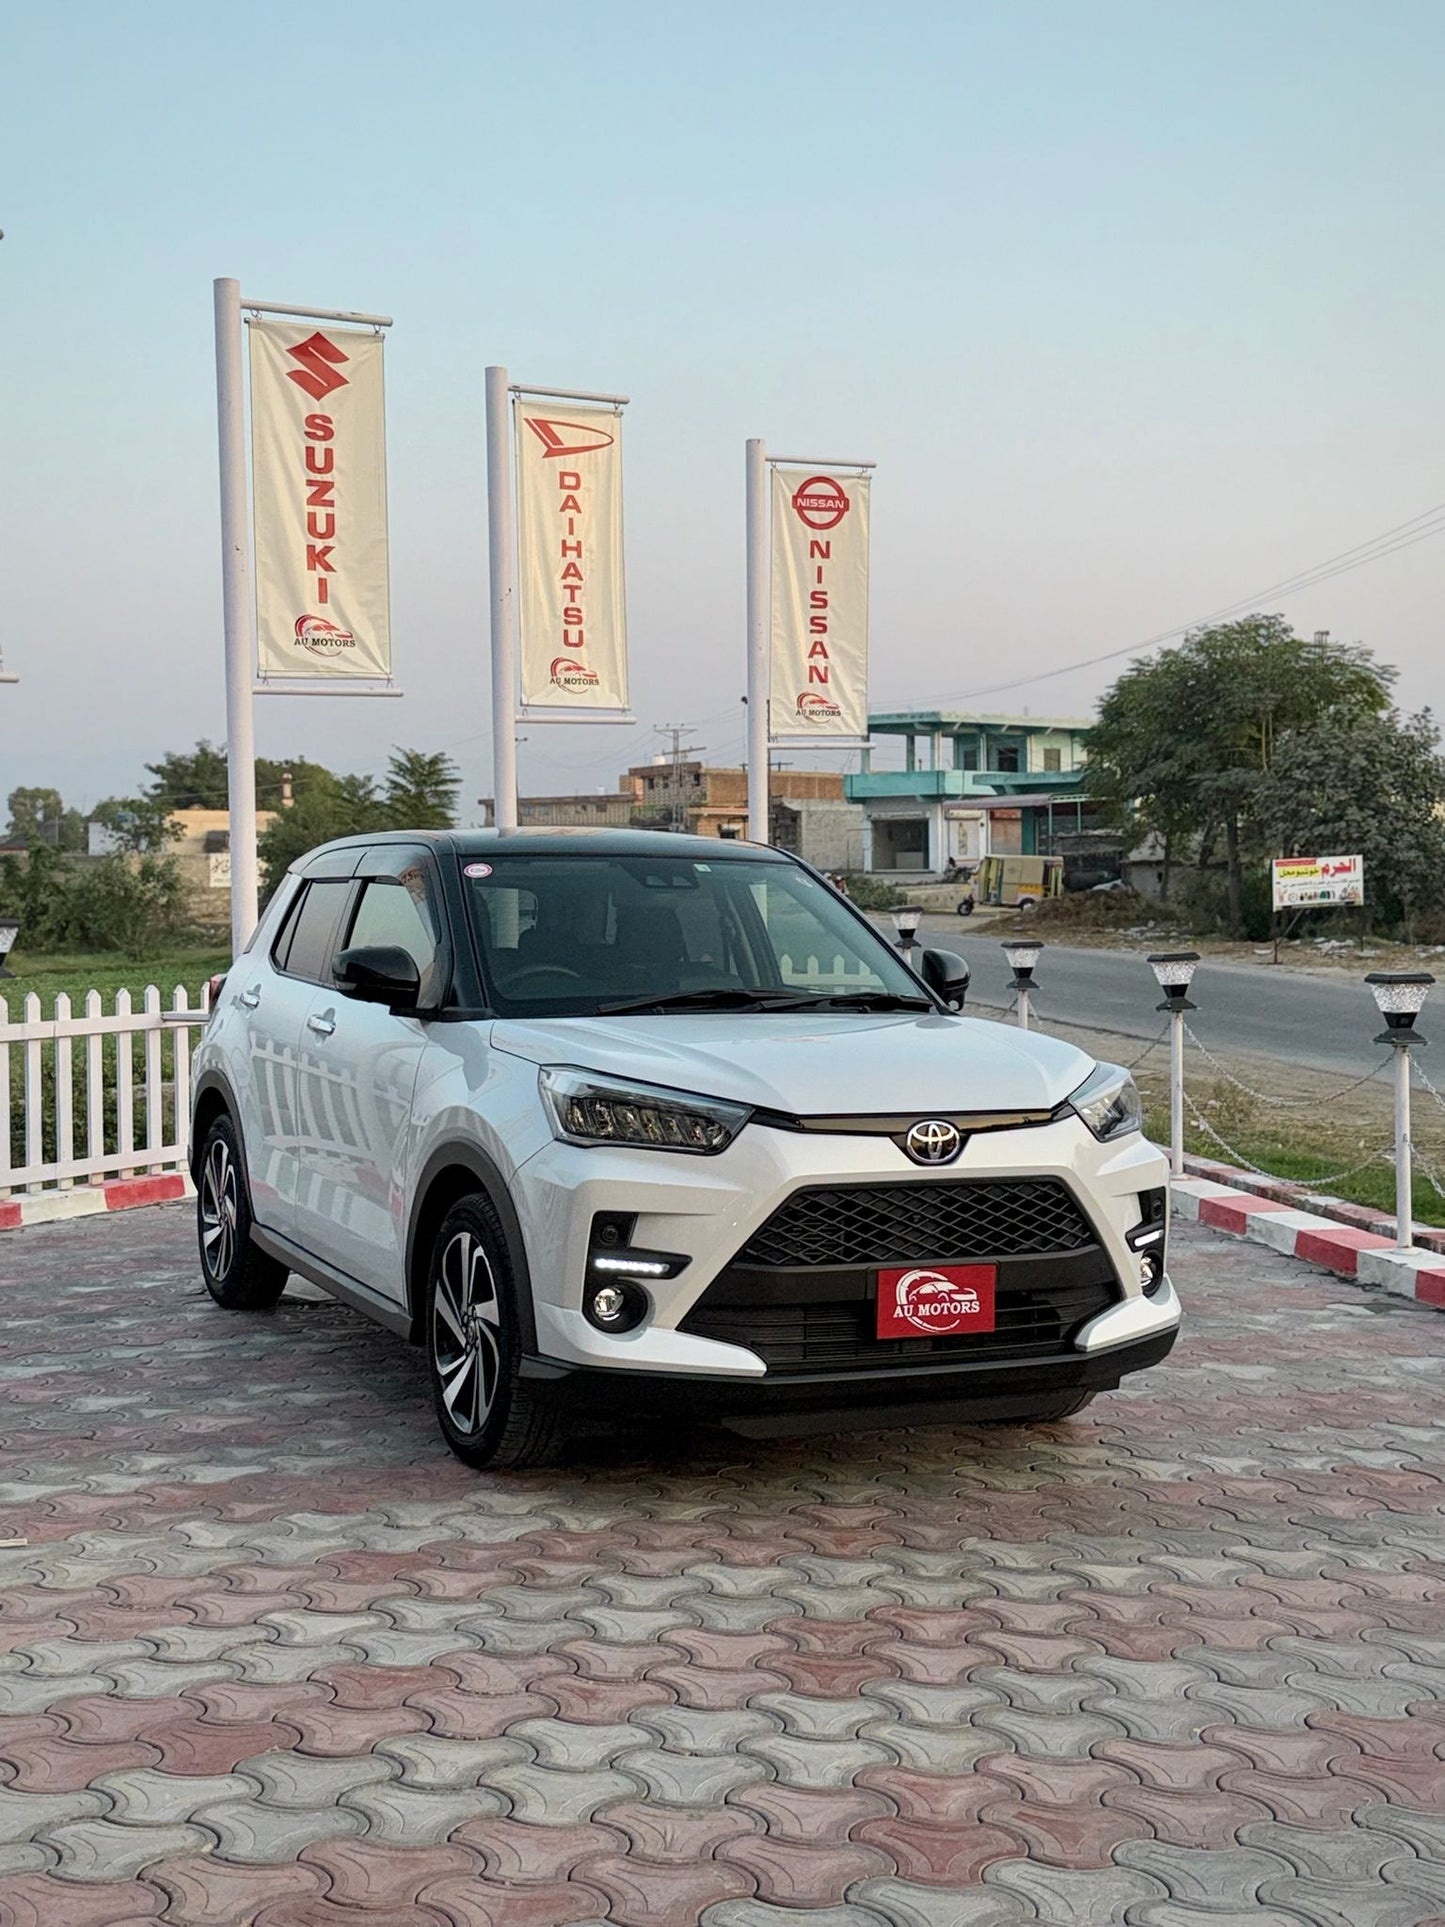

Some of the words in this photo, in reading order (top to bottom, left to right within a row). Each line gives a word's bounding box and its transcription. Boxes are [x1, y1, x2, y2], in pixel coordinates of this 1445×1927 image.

[304, 413, 337, 604] SUZUKI
[797, 498, 845, 509] NISSAN
[559, 471, 584, 648] DAIHATSU
[807, 540, 831, 684] NISSAN
[294, 637, 309, 646] AU
[311, 638, 356, 648] MOTORS
[549, 677, 562, 685] AU
[564, 677, 600, 686] MOTORS
[808, 709, 841, 717] MOTORS
[893, 1304, 914, 1318] AU
[918, 1301, 980, 1316] MOTORS
